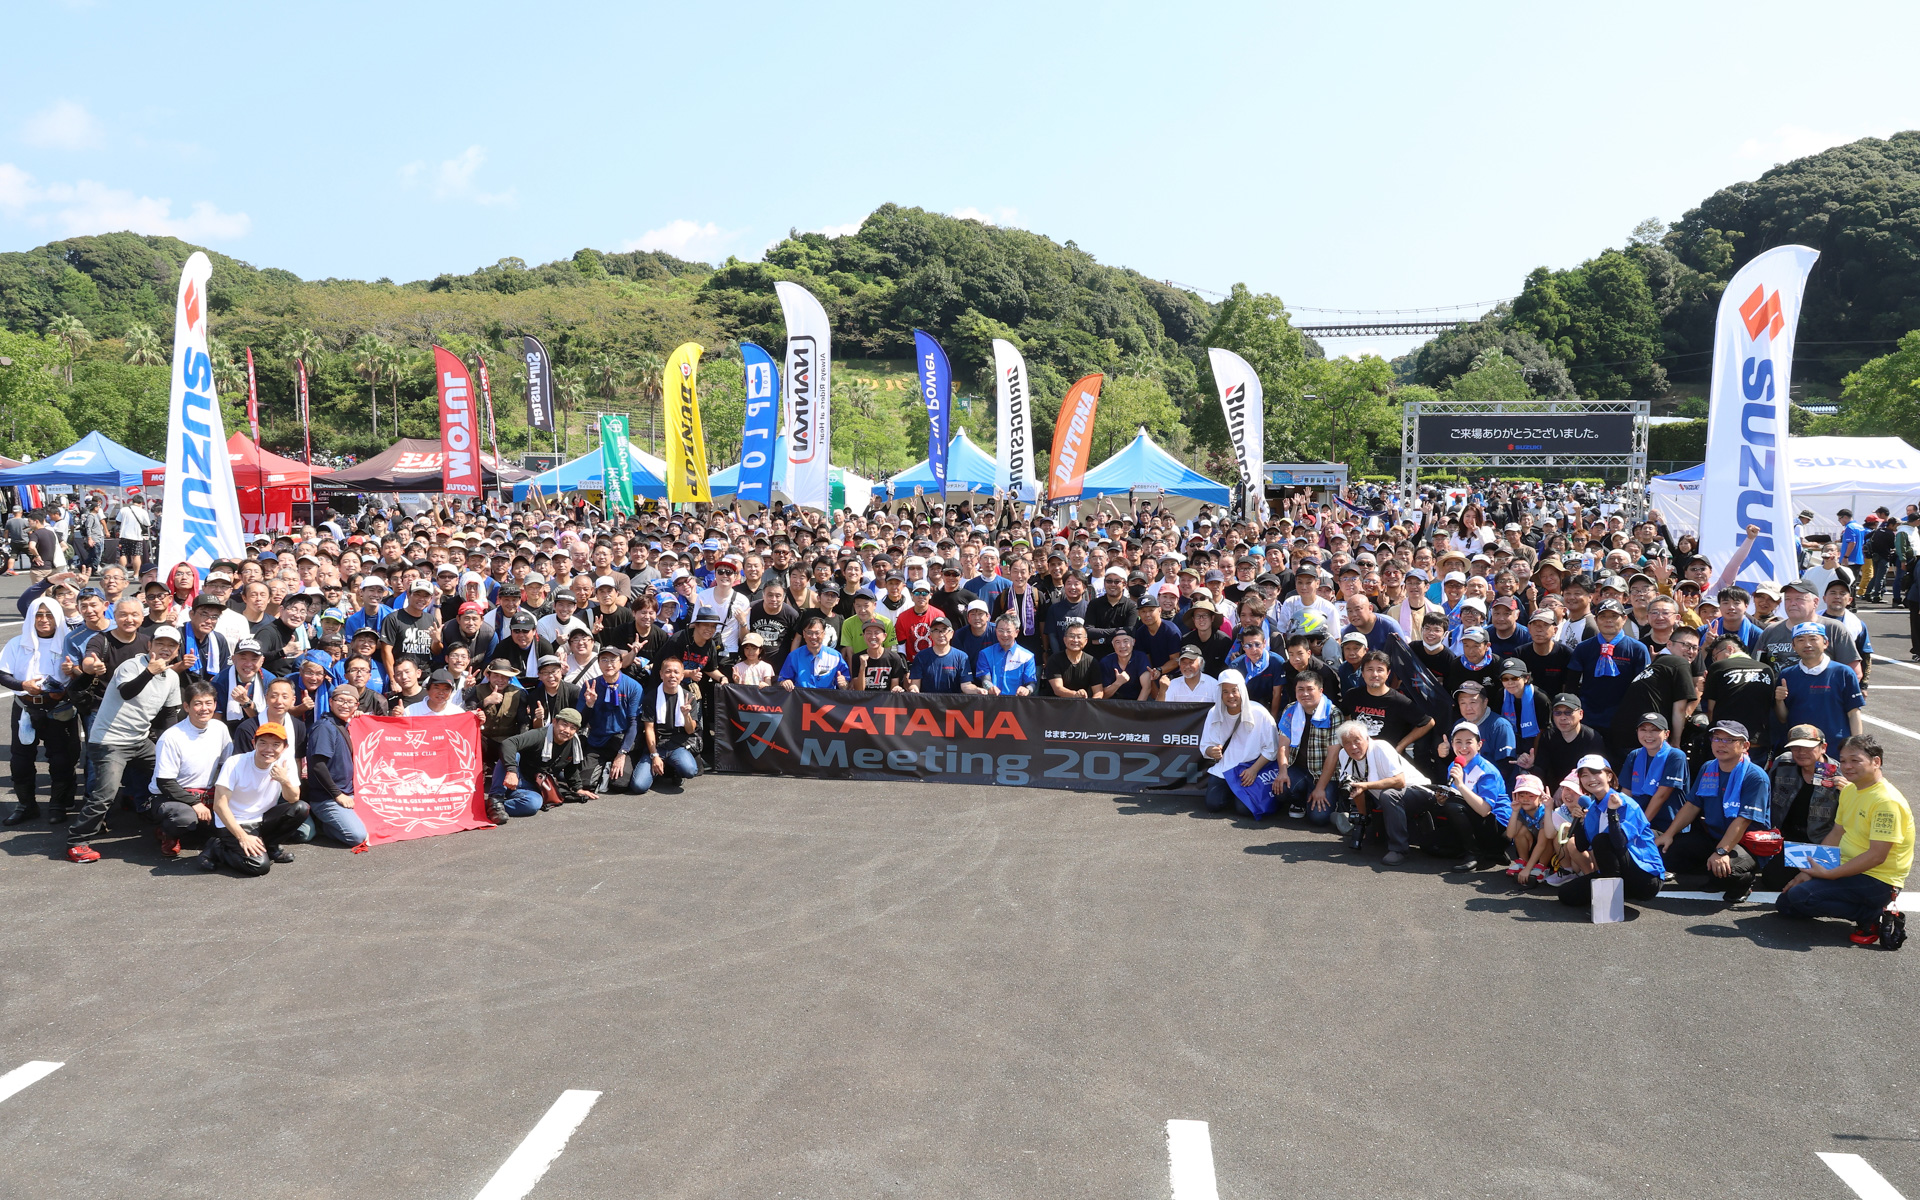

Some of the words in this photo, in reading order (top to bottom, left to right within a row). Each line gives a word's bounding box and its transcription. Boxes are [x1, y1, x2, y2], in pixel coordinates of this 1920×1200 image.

[680, 384, 698, 497] DUNLOP
[1055, 391, 1095, 485] DAYTONA
[1450, 427, 1599, 440] ご来場ありがとうございました。
[616, 435, 630, 481] 乗ろうよ
[1793, 457, 1908, 469] SUZUKI
[738, 703, 783, 713] KATANA
[1354, 706, 1386, 717] KATANA
[801, 703, 1028, 741] KATANA
[1044, 729, 1150, 743] はままつフルーツパーク時之栖
[1162, 734, 1199, 746] 9月8日
[800, 738, 1032, 786] Meeting
[1043, 748, 1203, 784] 2024
